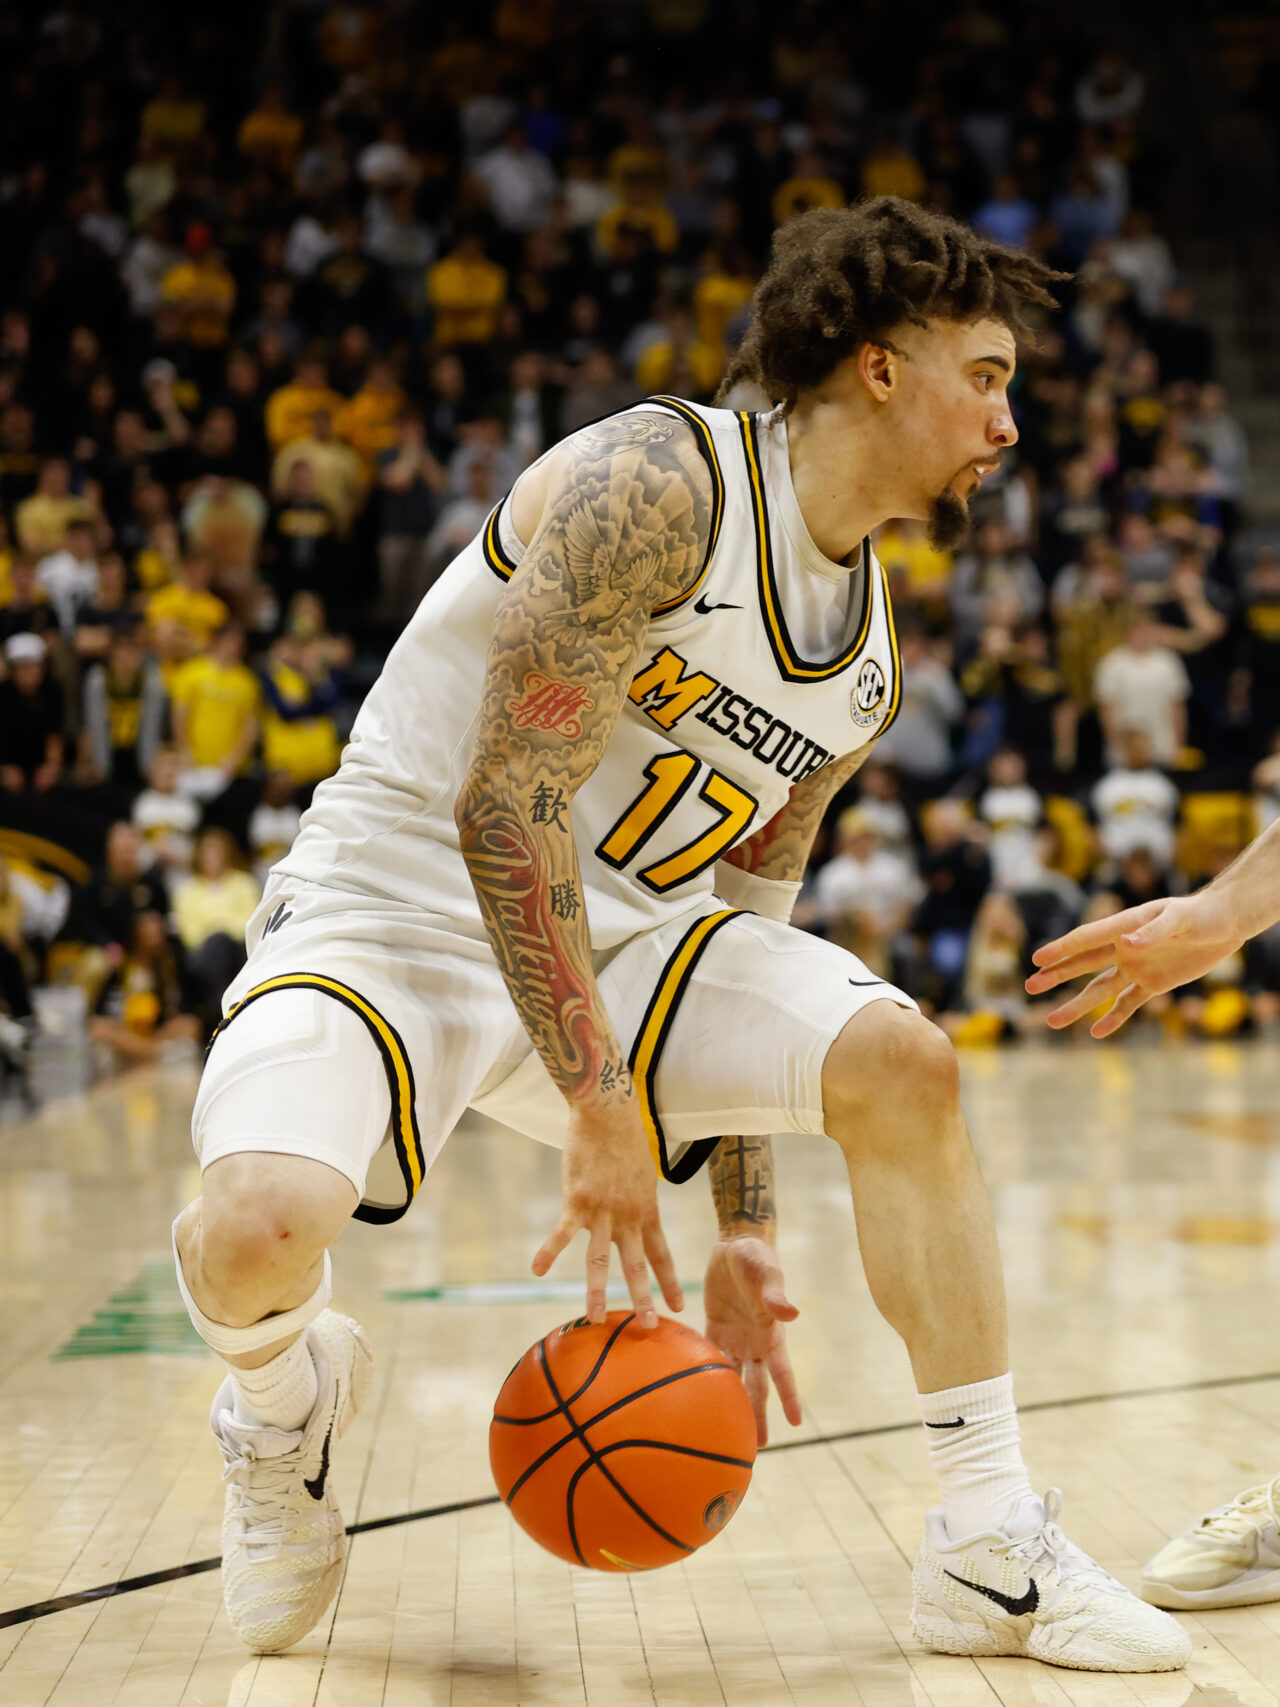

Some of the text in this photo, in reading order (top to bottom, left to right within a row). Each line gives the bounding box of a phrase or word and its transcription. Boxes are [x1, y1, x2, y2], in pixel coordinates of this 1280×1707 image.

[595, 749, 758, 894] 17
[463, 820, 565, 1045] Walking
[550, 878, 581, 922] 勝
